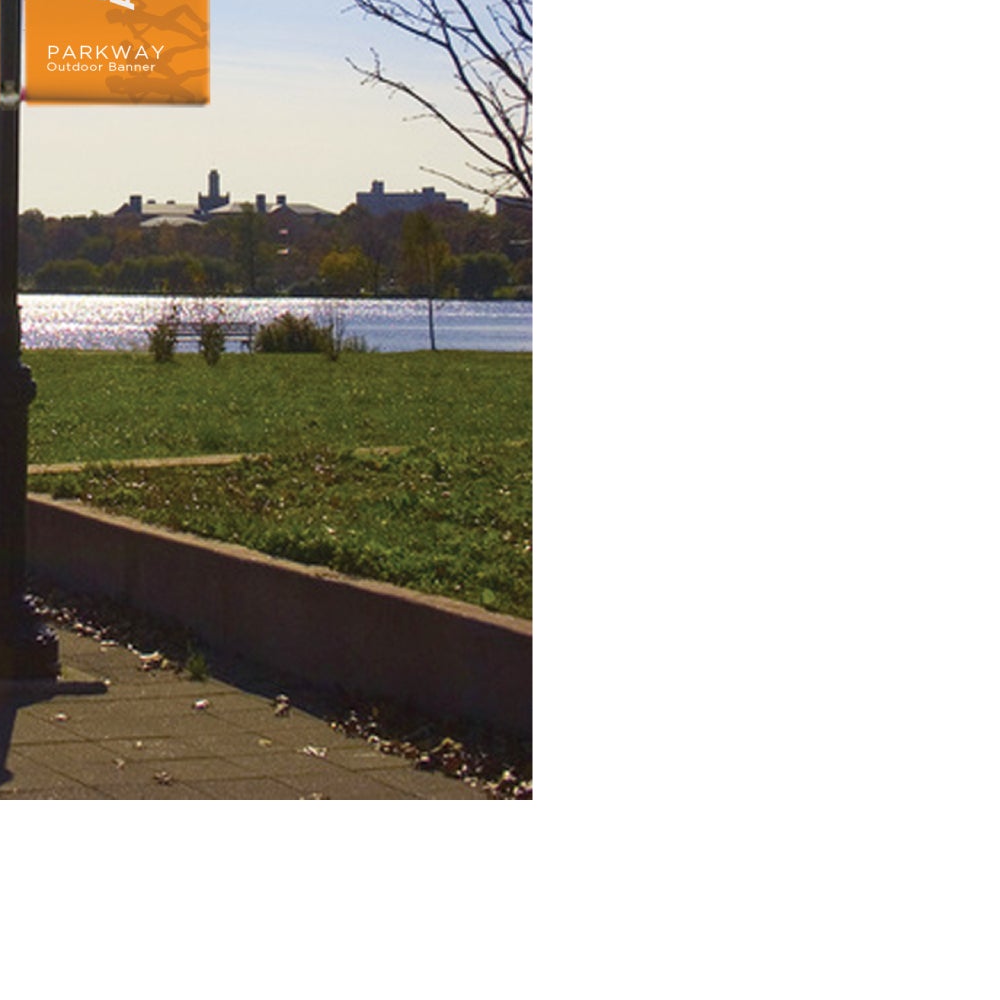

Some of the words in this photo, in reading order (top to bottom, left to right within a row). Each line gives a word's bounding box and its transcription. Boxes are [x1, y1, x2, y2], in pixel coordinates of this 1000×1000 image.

[47, 45, 166, 60] PARKWAY
[46, 62, 104, 72] Outdoor
[108, 62, 156, 72] Banner
